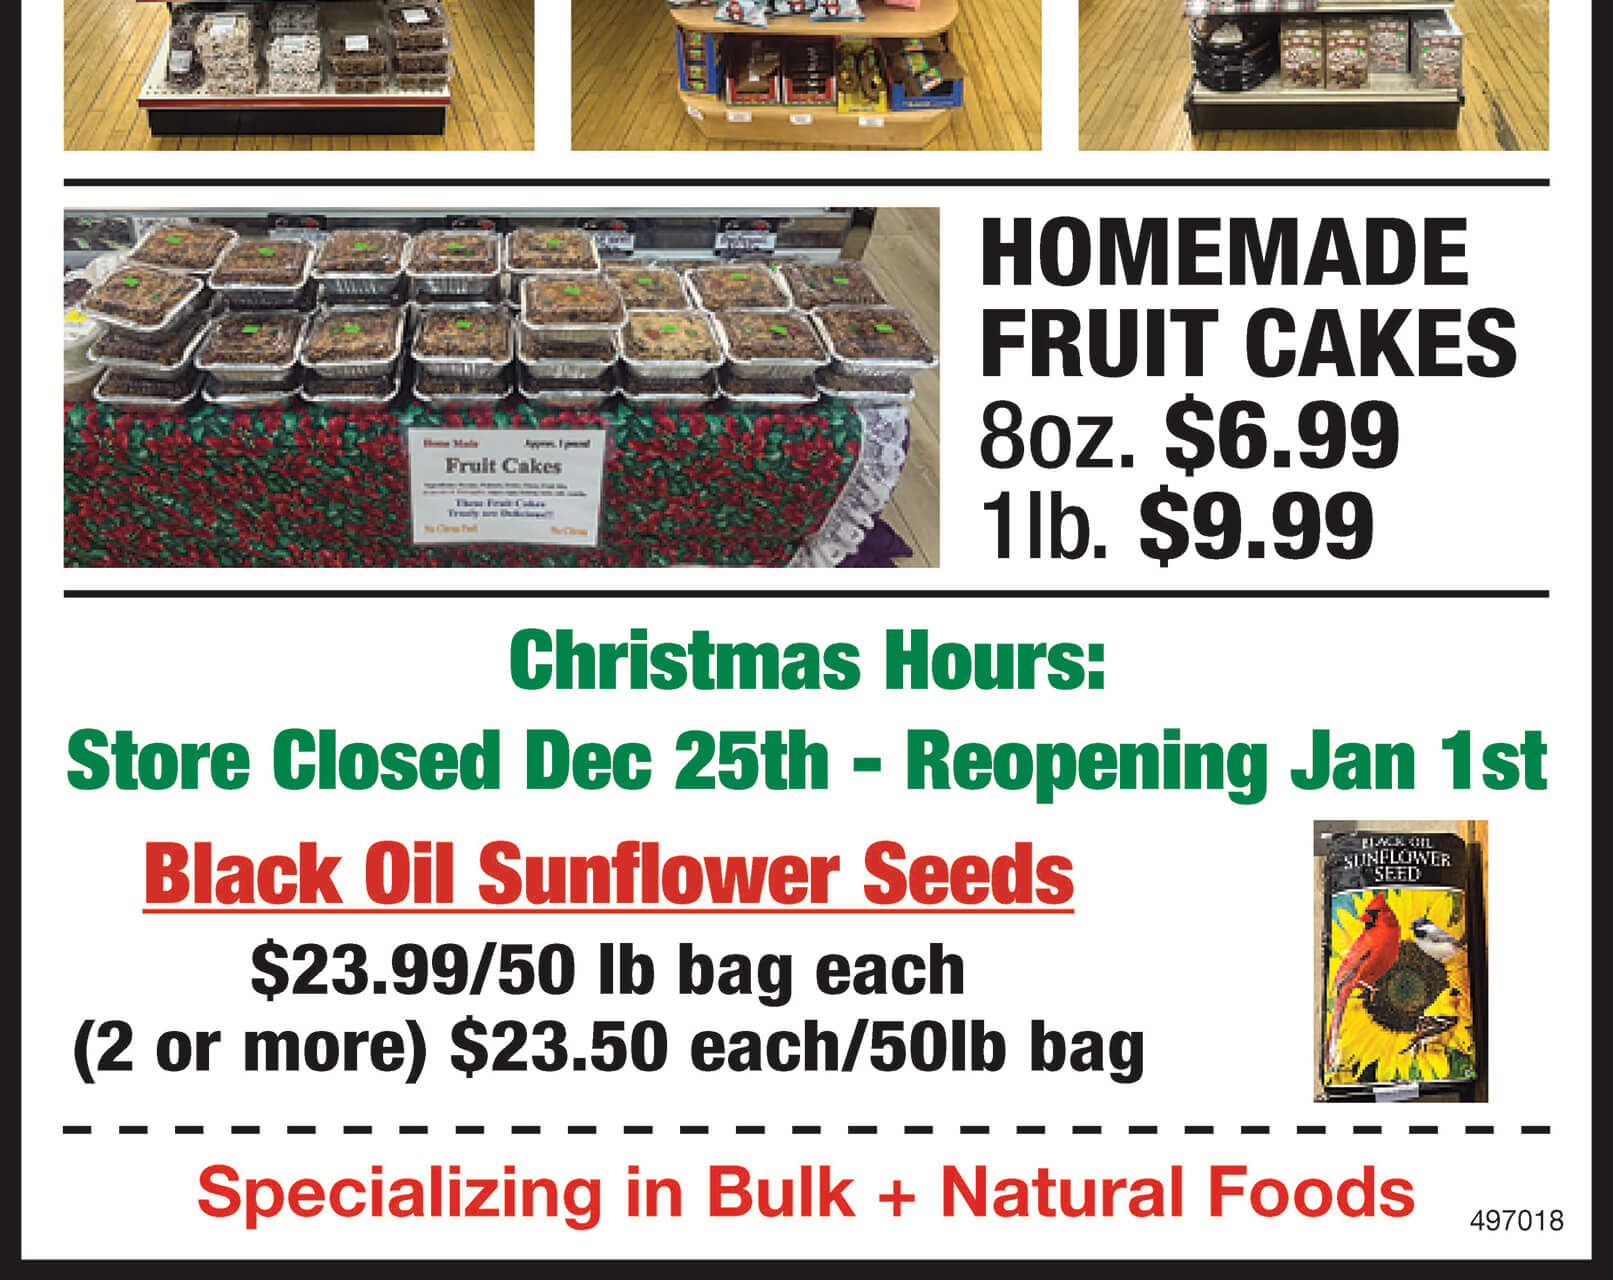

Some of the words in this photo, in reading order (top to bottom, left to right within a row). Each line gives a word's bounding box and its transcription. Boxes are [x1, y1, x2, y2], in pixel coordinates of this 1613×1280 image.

[983, 216, 1468, 286] HOMEMADE
[983, 309, 1218, 377] FRUIT
[1247, 308, 1516, 377] CAKES
[445, 456, 497, 474] Fruit
[502, 456, 563, 474] Cakes
[981, 400, 1133, 469] 8oz.
[1166, 392, 1398, 477] $6.99
[487, 498, 513, 508] Fruit
[514, 498, 546, 508] Cakes
[984, 491, 1106, 559] 1lb.
[1140, 483, 1373, 568] $9.99
[511, 628, 860, 690] Christmas
[886, 629, 1104, 690] Hours:
[68, 728, 249, 790] Store
[274, 728, 500, 790] Closed
[527, 729, 651, 790] Dec
[675, 729, 828, 790] 25th
[854, 758, 881, 771] -
[908, 728, 1267, 805] Reopening
[1291, 729, 1414, 790] Jan
[1442, 730, 1547, 790] 1st
[146, 842, 343, 904] Black
[366, 841, 453, 904] Oil
[479, 841, 840, 904] Sunflower
[864, 841, 1073, 904] Seeds
[1343, 848, 1452, 870] SUNFLOWER
[1362, 837, 1405, 849] BLACK
[1374, 866, 1422, 882] SEED
[252, 938, 574, 1001] $23.99/50
[600, 943, 654, 995] lb
[680, 943, 792, 1007] bag
[817, 943, 963, 995] each
[75, 1020, 132, 1084] (2
[157, 1031, 221, 1072] or
[245, 1020, 426, 1084] more)
[451, 1015, 667, 1078] $23.50
[691, 1019, 1005, 1072] each/50lb
[1032, 1020, 1143, 1084] bag
[198, 1165, 600, 1231] Specializing
[628, 1165, 681, 1216] in
[710, 1165, 856, 1217] Bulk
[879, 1180, 915, 1216] +
[944, 1165, 1182, 1217] Natural
[1211, 1165, 1414, 1217] Foods
[1471, 1210, 1563, 1231] 497018
